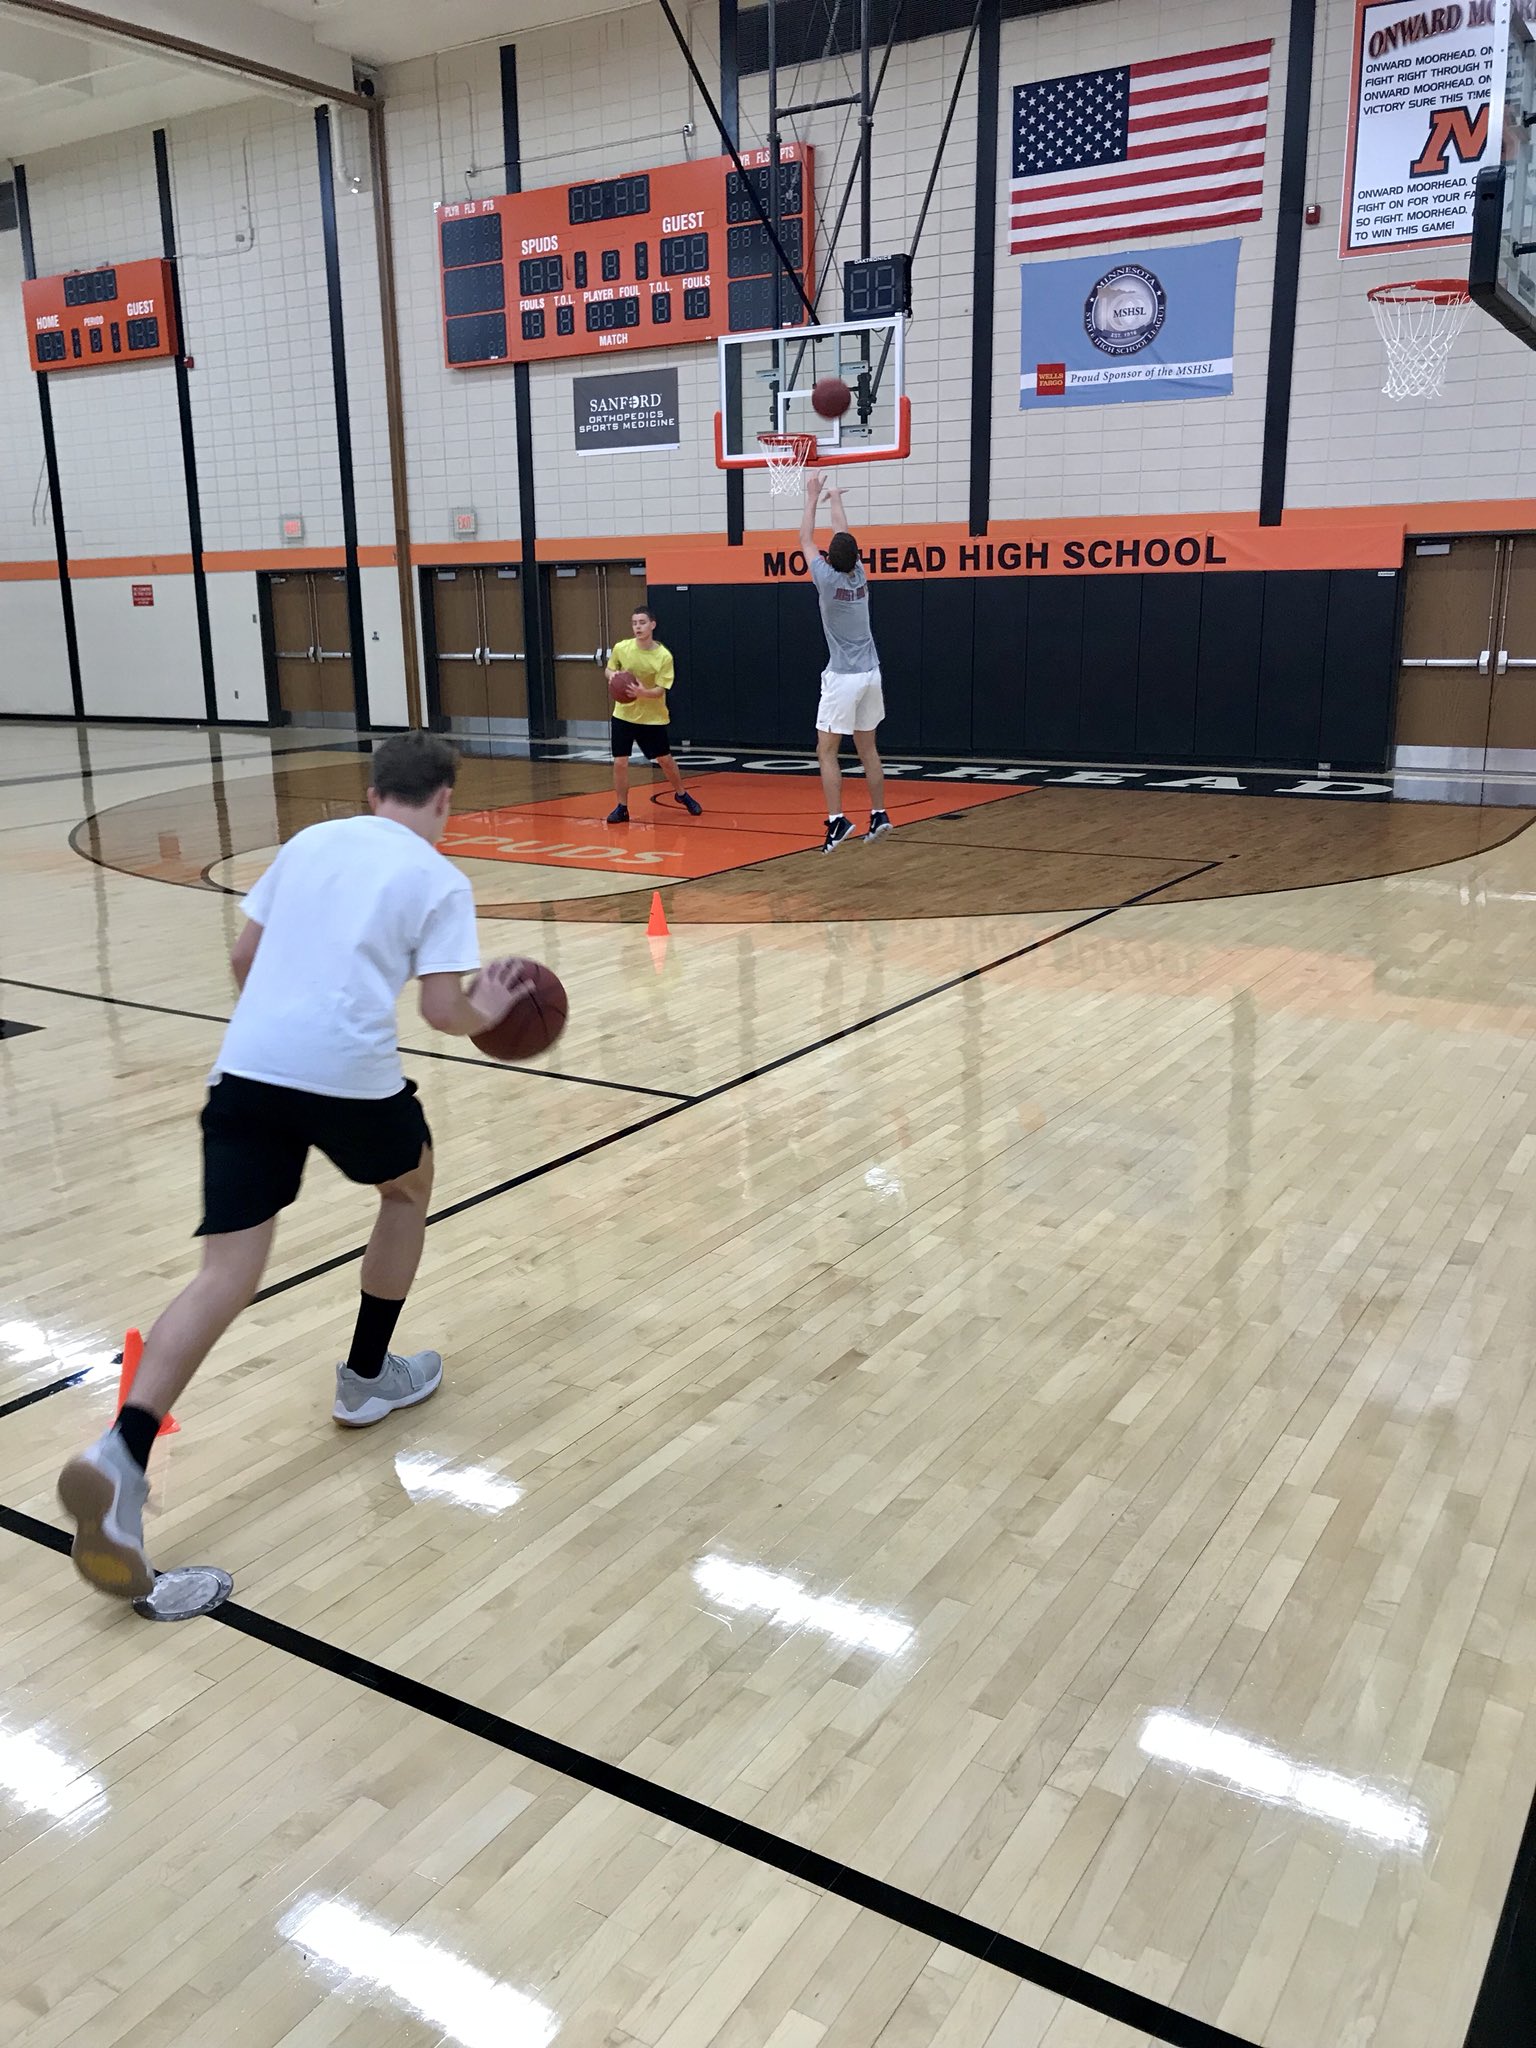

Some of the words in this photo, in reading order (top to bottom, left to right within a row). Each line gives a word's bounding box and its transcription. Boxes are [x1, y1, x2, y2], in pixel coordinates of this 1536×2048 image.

[1368, 4, 1463, 58] ONWARD
[1365, 75, 1394, 87] FIGHT
[1397, 70, 1427, 82] RIGHT
[1431, 62, 1480, 78] THROUGH
[1366, 59, 1412, 73] ONWARD
[1364, 87, 1410, 101] ONWARD
[1363, 101, 1406, 115] VICTORY
[1408, 97, 1437, 109] SURE
[1440, 93, 1463, 104] THIS
[756, 150, 770, 163] FLS
[780, 146, 794, 160] PTS
[1357, 186, 1404, 200] ONWARD
[464, 202, 475, 214] FLS
[482, 199, 495, 212] PTS
[1357, 202, 1386, 213] FIGHT
[1389, 200, 1404, 209] ON
[1407, 197, 1429, 207] FOR
[1432, 192, 1460, 203] YOUR
[662, 211, 704, 234] GUEST
[1356, 218, 1370, 227] SO
[1355, 231, 1369, 241] TO
[1372, 228, 1393, 238] WIN
[1396, 225, 1419, 236] THIS
[521, 235, 559, 256] SPUDS
[1096, 266, 1156, 289] MINNESOTA
[519, 298, 545, 311] FOULS
[554, 294, 576, 307] T.O.L.
[583, 288, 613, 303] PLAYER
[619, 285, 640, 298] FOUL
[649, 282, 673, 294] T.O.L.
[682, 275, 711, 289] FOULS
[126, 299, 154, 317] GUEST
[1113, 306, 1147, 319] MSHSL
[36, 315, 60, 330] HOME
[83, 315, 104, 327] PERIOD
[1085, 310, 1095, 339] STATE
[1094, 337, 1115, 354] HIGH
[1115, 339, 1148, 355] SCHOOL
[1147, 304, 1165, 340] LEAGUE
[599, 333, 628, 346] MATCH
[1070, 374, 1100, 384] Proud
[1102, 370, 1142, 384] Sponsor
[1145, 366, 1157, 380] of
[1157, 367, 1173, 377] the
[1176, 363, 1215, 376] MSHSL
[1039, 379, 1064, 387] FARGO
[589, 393, 662, 412] SANFORD
[579, 422, 619, 433] SPORTS
[622, 418, 675, 430] MEDICINE
[588, 410, 664, 424] ORTHOPEDICS
[763, 546, 948, 577] MOHEAD
[958, 542, 1049, 572] HIGH
[1062, 536, 1227, 569] SCHOOL
